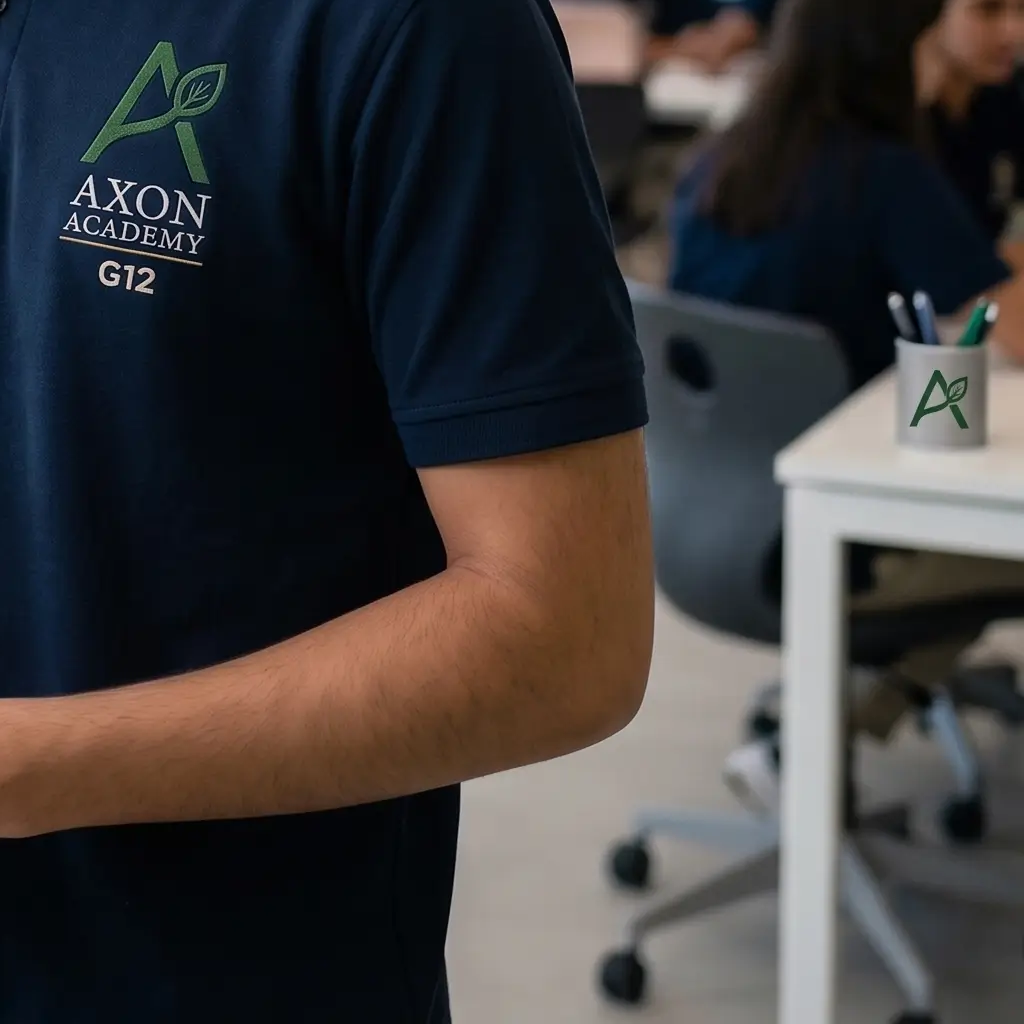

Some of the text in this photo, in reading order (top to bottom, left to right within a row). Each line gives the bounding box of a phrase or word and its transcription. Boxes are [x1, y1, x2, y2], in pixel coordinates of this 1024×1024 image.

[69, 174, 212, 229] AXON
[62, 211, 205, 255] ACADEMY
[98, 260, 156, 295] G12
